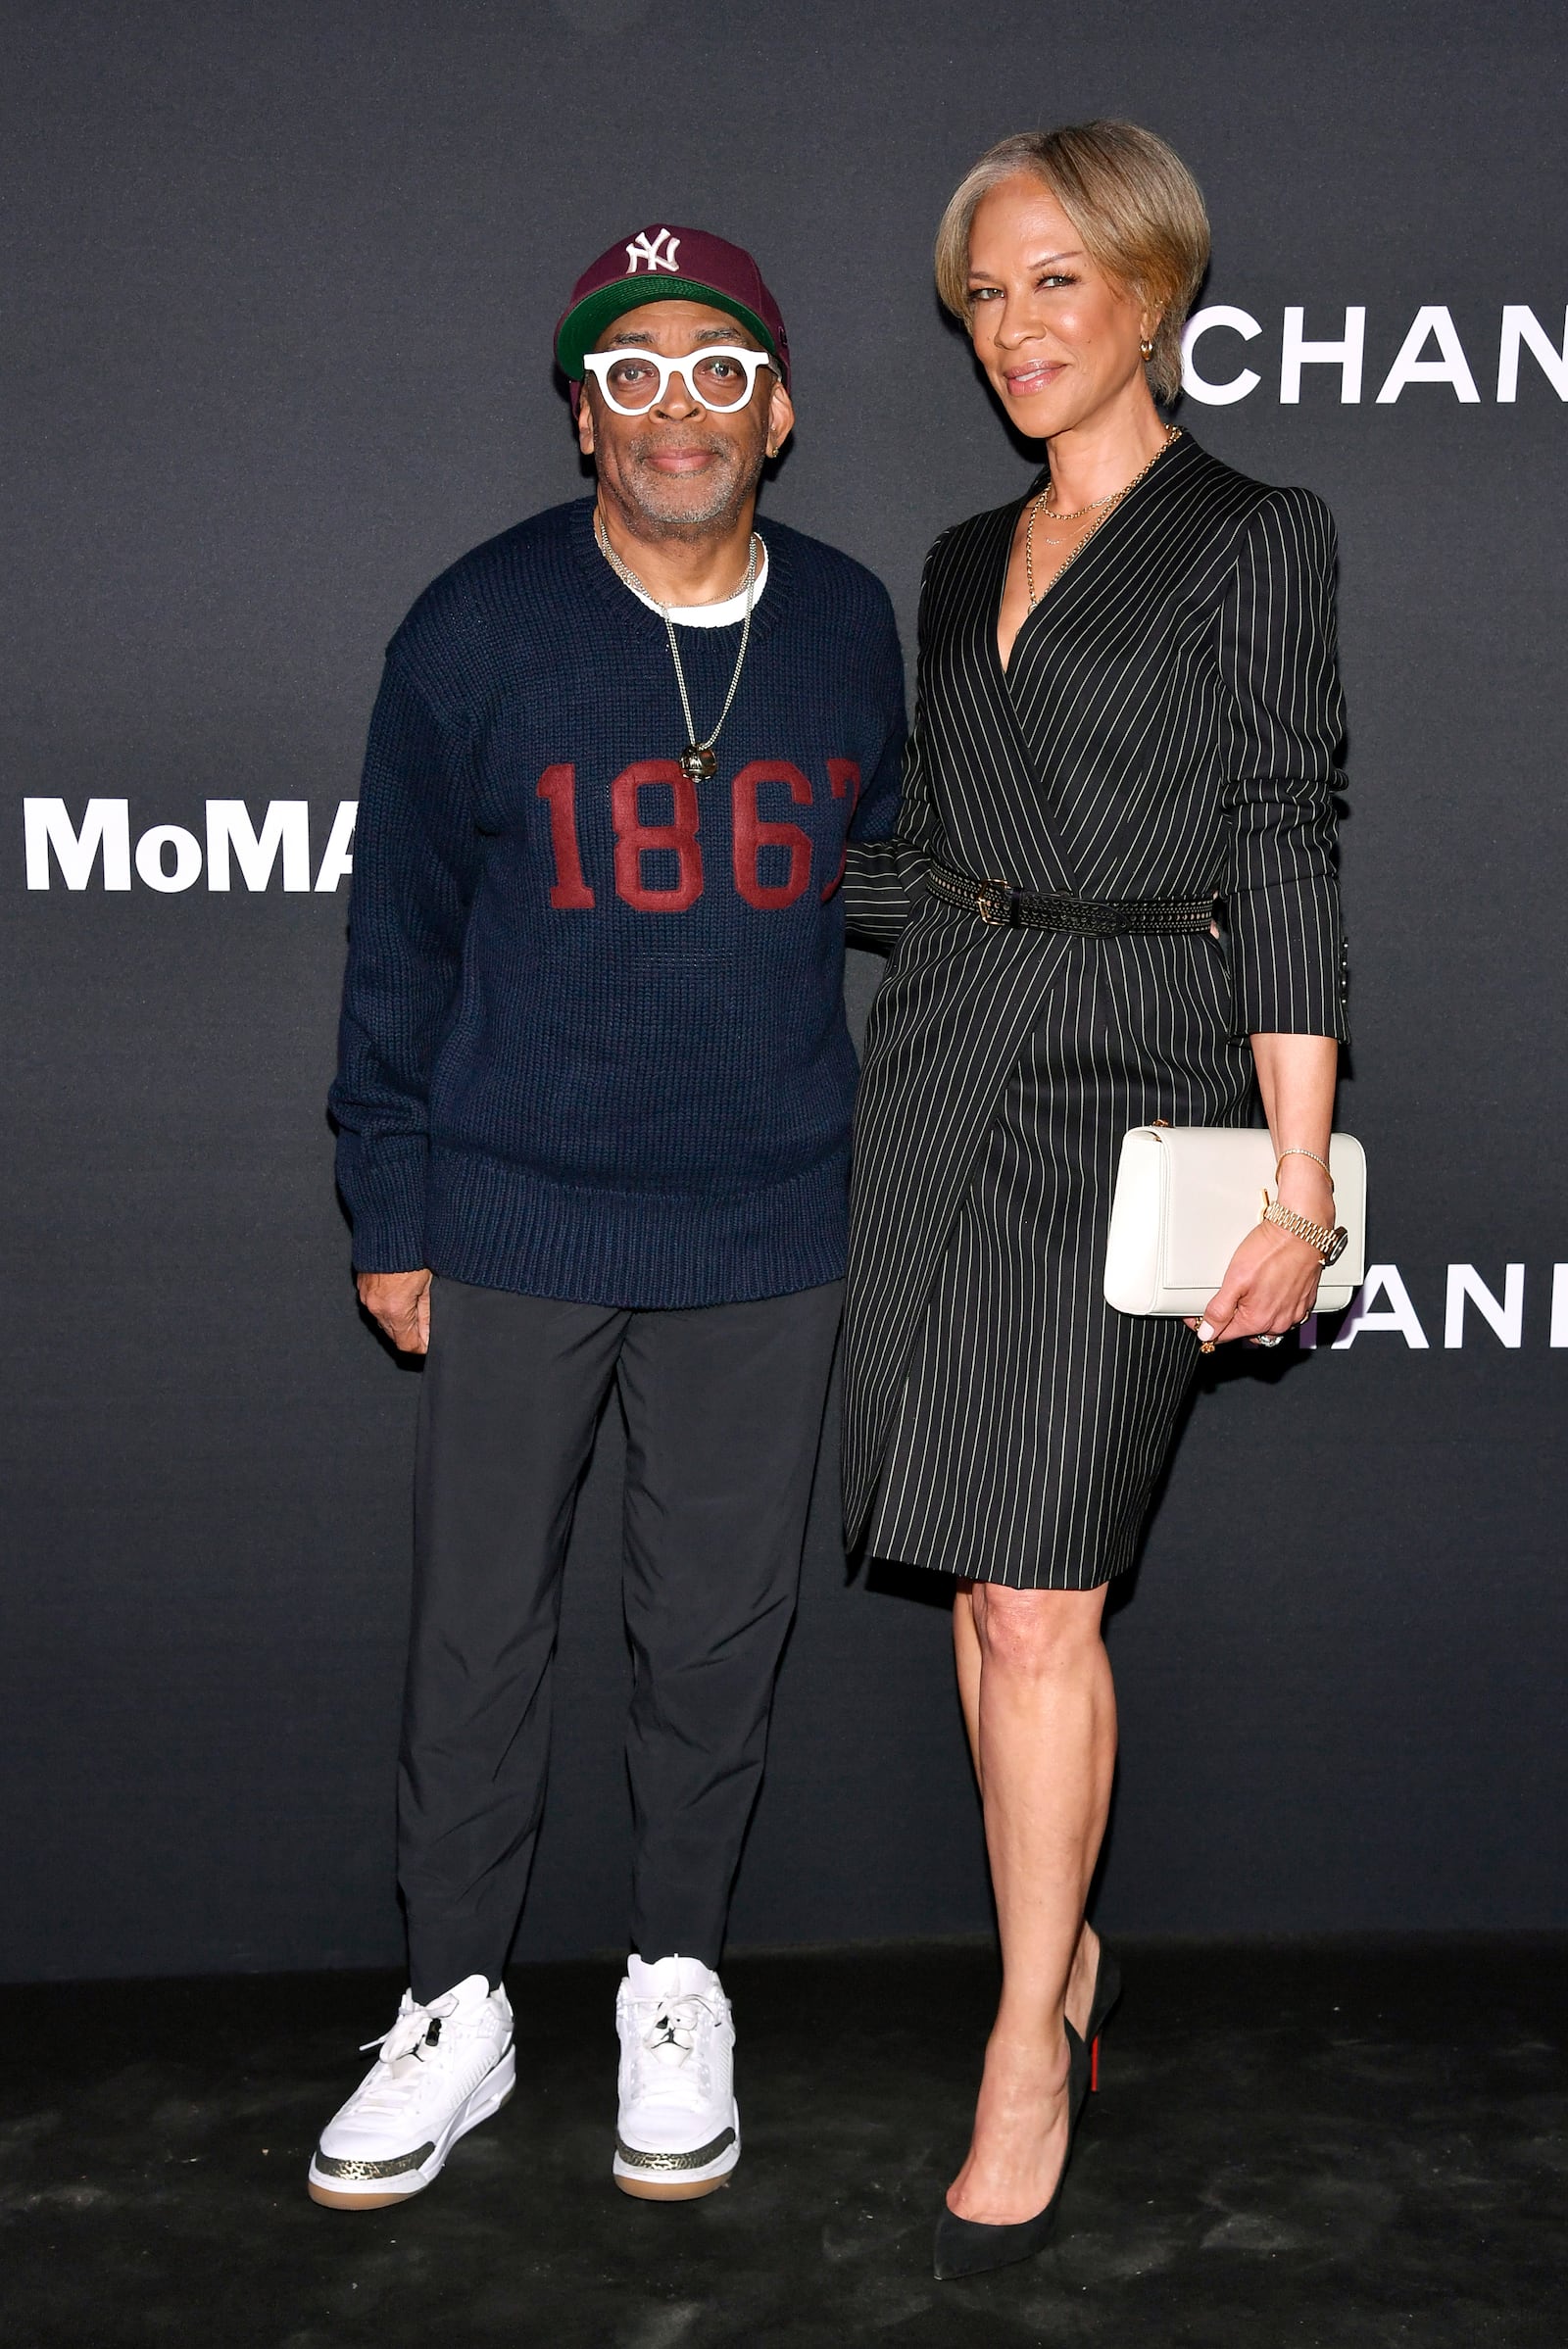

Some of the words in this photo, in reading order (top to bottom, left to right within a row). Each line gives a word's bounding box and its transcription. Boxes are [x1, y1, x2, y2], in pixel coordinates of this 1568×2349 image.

[625, 227, 681, 274] NY
[1182, 305, 1568, 406] CHAN
[1299, 1262, 1568, 1351] AN
